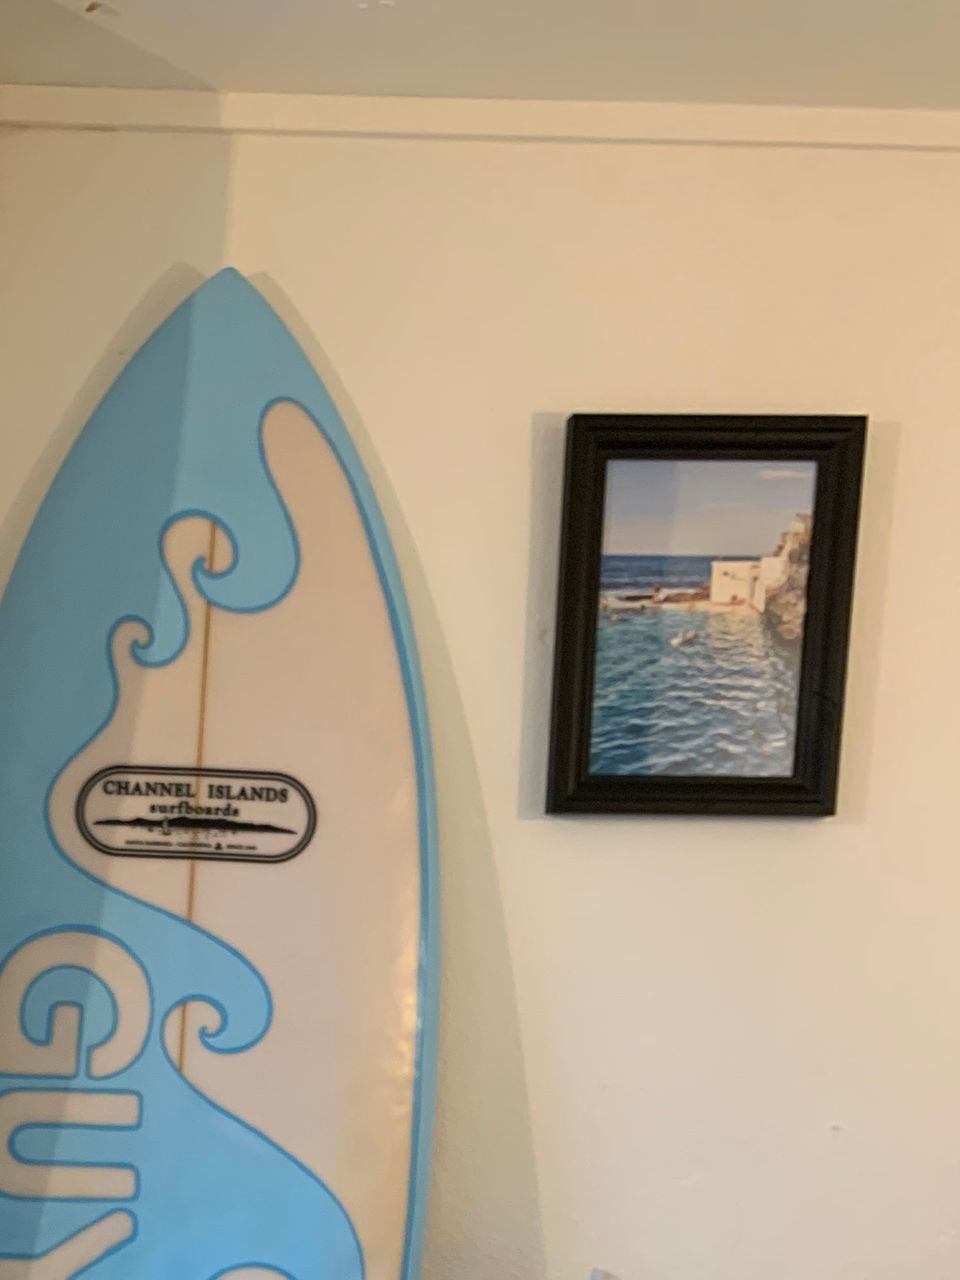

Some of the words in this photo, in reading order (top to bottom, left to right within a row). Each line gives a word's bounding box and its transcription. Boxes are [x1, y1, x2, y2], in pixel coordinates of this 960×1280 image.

[102, 780, 197, 798] CHANNEL
[207, 784, 289, 803] ISLANDS
[149, 801, 240, 817] surfboards
